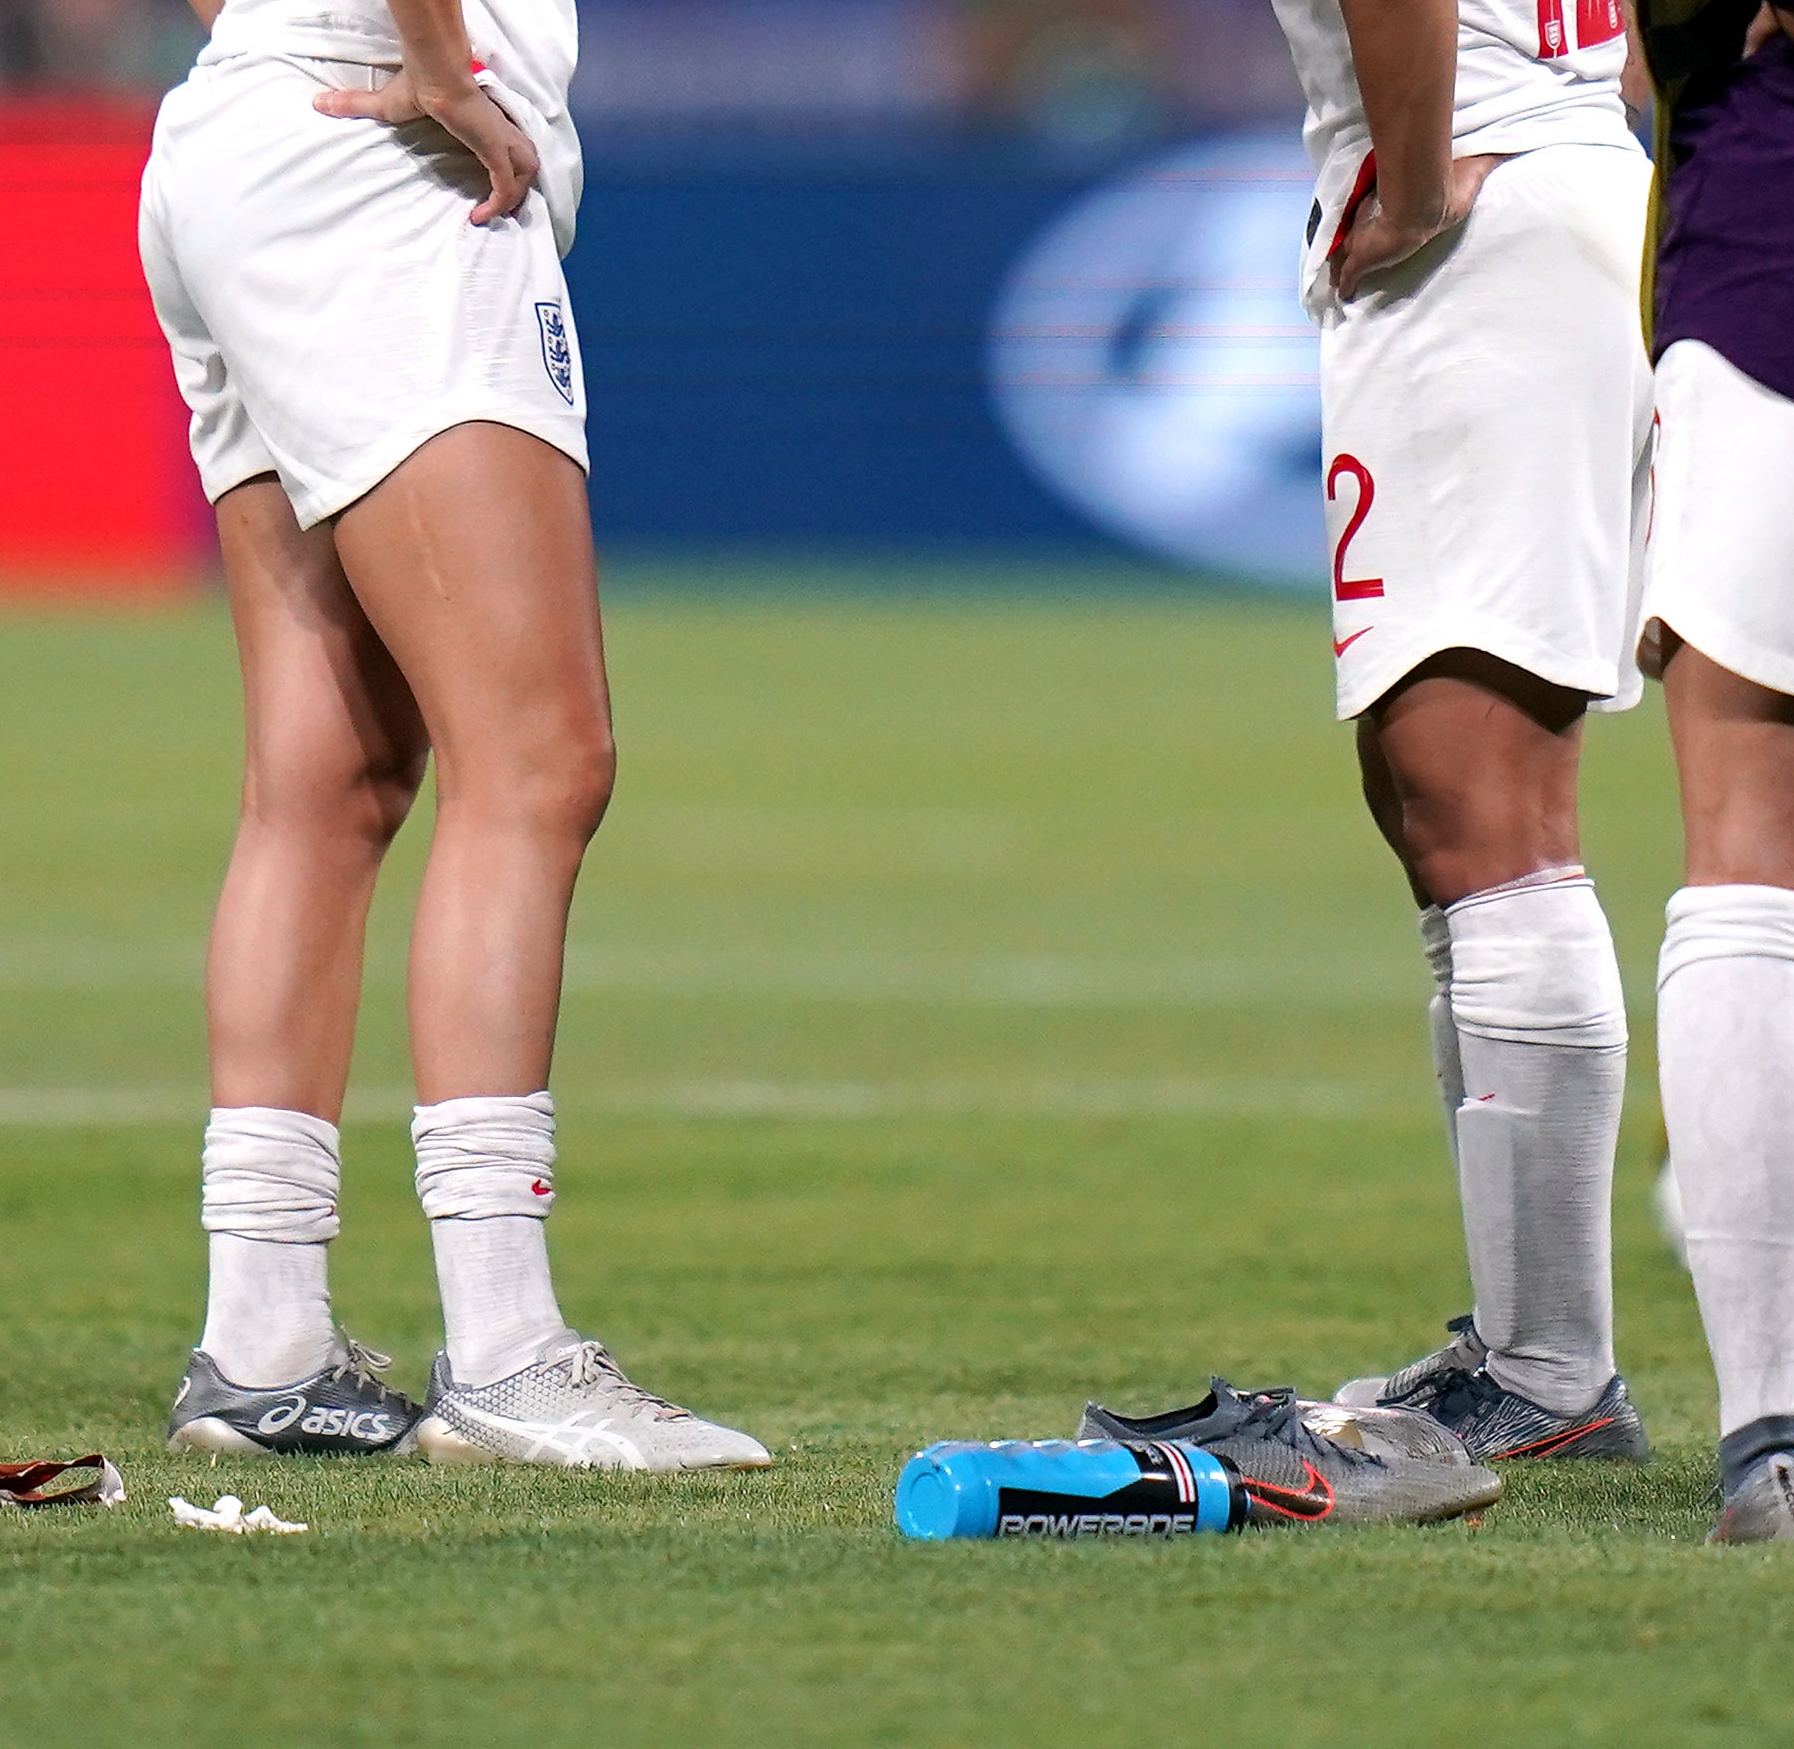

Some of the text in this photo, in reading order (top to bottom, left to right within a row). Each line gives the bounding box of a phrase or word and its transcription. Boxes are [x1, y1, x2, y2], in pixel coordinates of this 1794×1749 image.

[1327, 453, 1385, 602] 2
[301, 1406, 393, 1443] asics
[998, 1514, 1195, 1537] POWERADE
